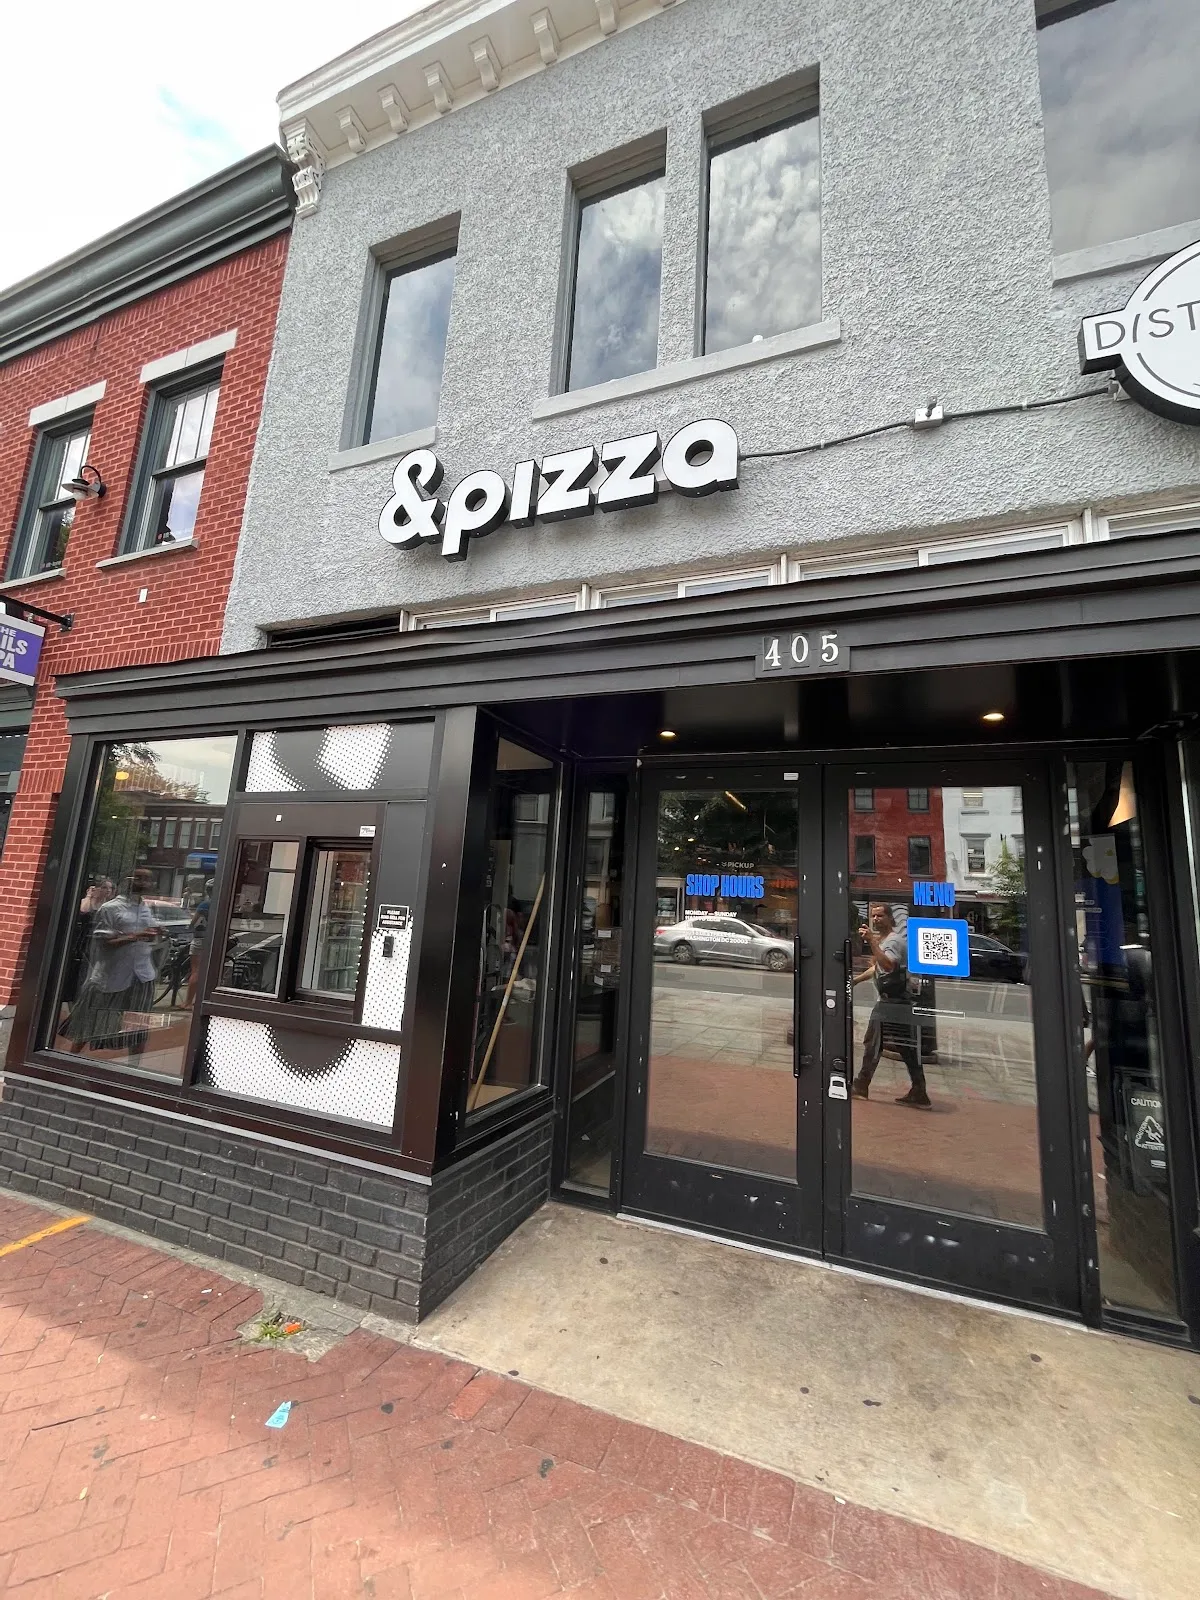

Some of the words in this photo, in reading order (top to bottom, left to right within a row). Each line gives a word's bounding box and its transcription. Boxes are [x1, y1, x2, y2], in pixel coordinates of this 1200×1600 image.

[378, 418, 740, 557] &pizza
[0, 626, 17, 637] HE
[765, 634, 839, 667] 405
[727, 861, 755, 869] PICKUP
[686, 873, 720, 897] SHOP
[720, 874, 765, 899] HOURS
[913, 881, 956, 908] MENU
[714, 910, 738, 918] SUNDAY
